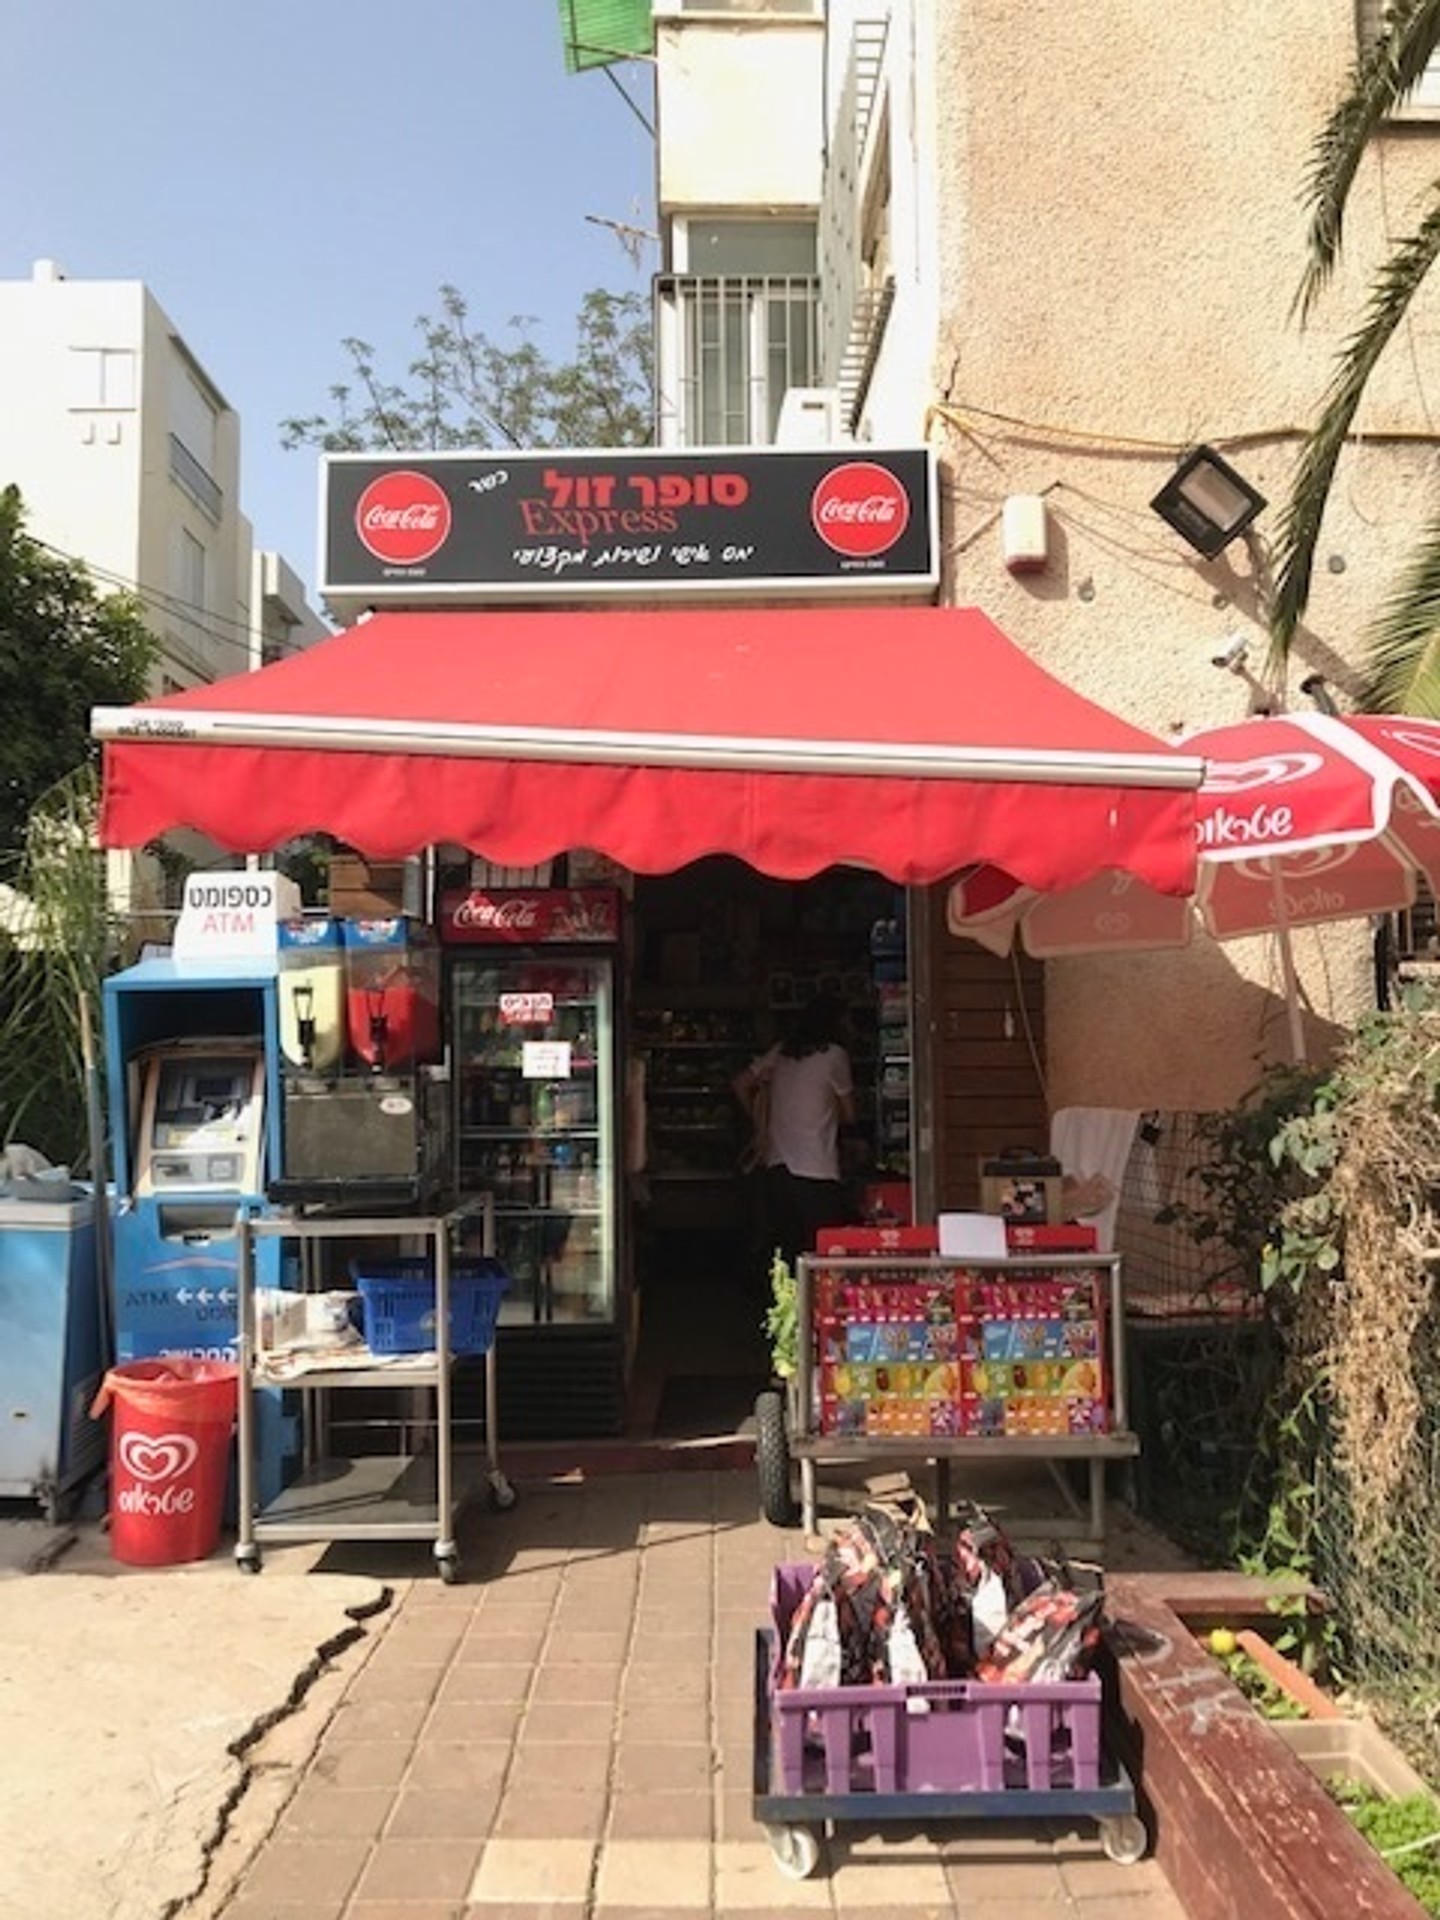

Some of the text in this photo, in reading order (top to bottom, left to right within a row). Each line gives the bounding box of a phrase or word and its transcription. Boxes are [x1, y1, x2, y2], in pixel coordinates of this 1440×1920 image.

[543, 468, 749, 508] סופר זול
[520, 499, 679, 545] Express
[513, 546, 588, 574] מקצועי
[671, 544, 711, 564] אישי
[722, 546, 755, 562] יחס
[189, 885, 272, 909] כספומט
[201, 912, 254, 934] ATM
[118, 1482, 194, 1516] שטראוס
